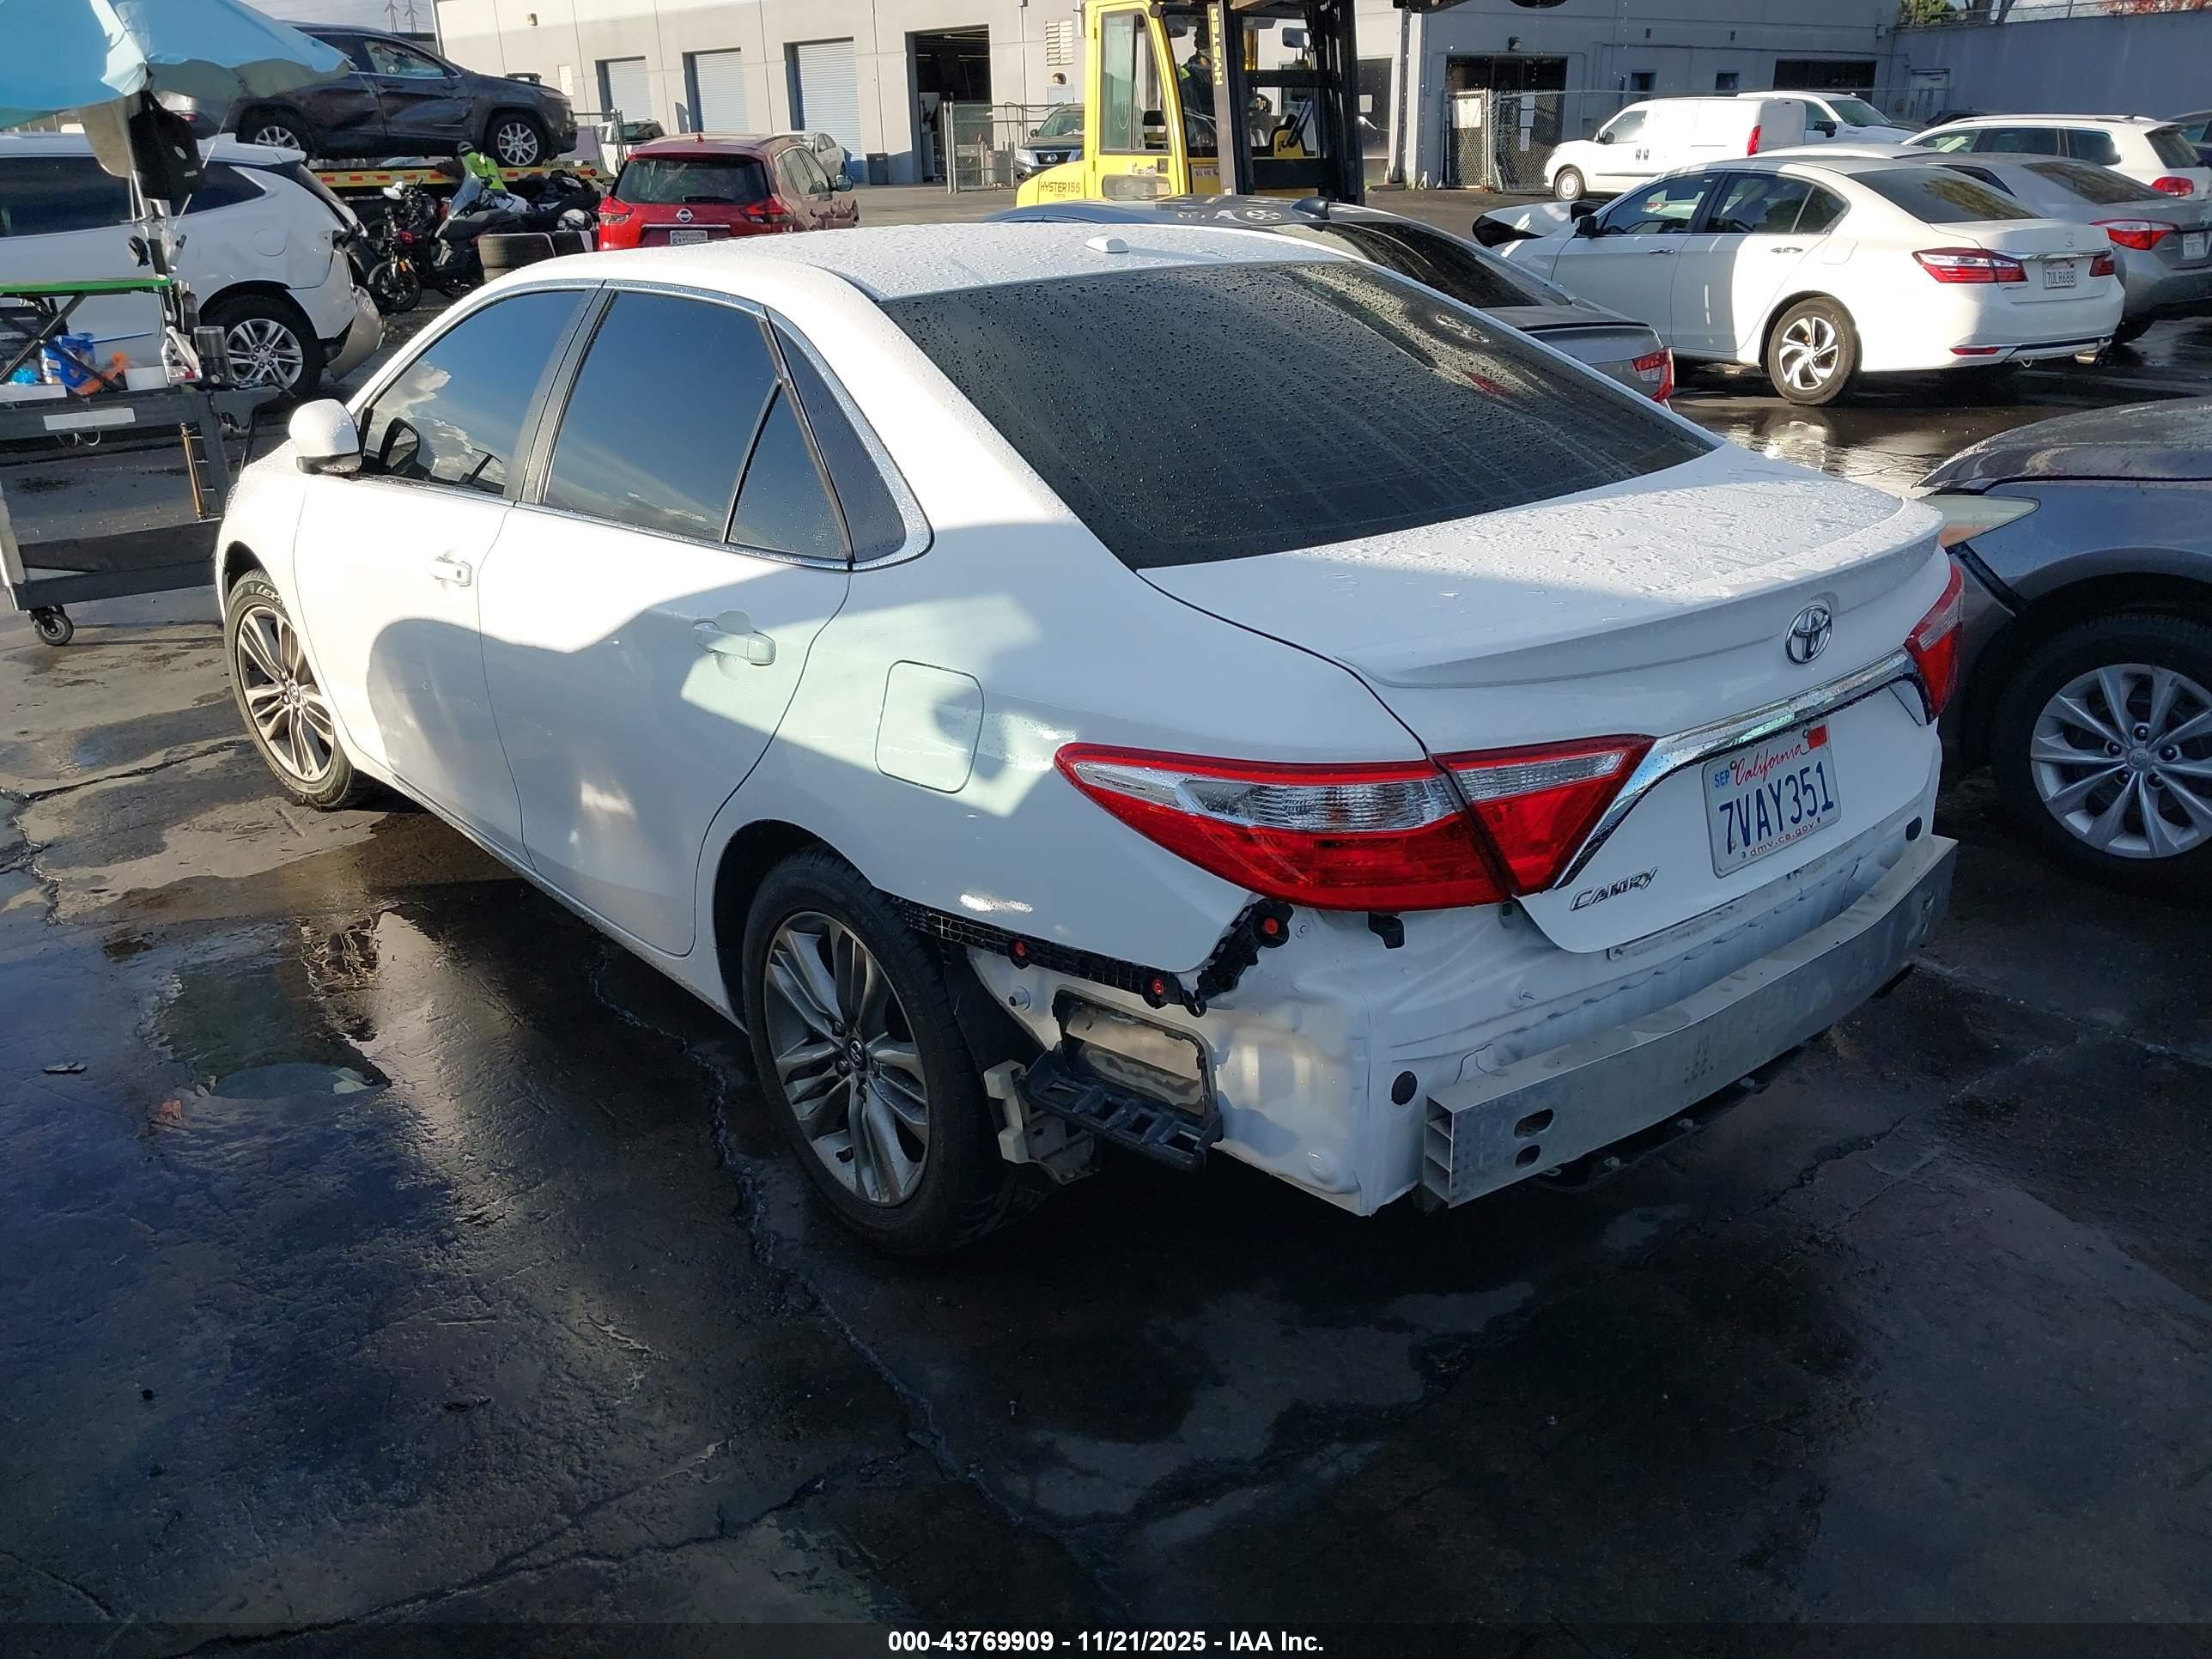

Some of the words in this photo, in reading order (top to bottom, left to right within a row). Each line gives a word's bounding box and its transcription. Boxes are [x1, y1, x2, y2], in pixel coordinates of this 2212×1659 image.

[1211, 8, 1223, 85] HYSTER
[1040, 181, 1066, 193] HYSTER
[1067, 181, 1081, 193] 155
[1714, 769, 1730, 788] SEP
[1733, 742, 1810, 787] California
[1719, 761, 1834, 855] 7VAY351
[1749, 821, 1814, 857] dmv.ca.gov
[1570, 866, 1659, 911] CAMRY
